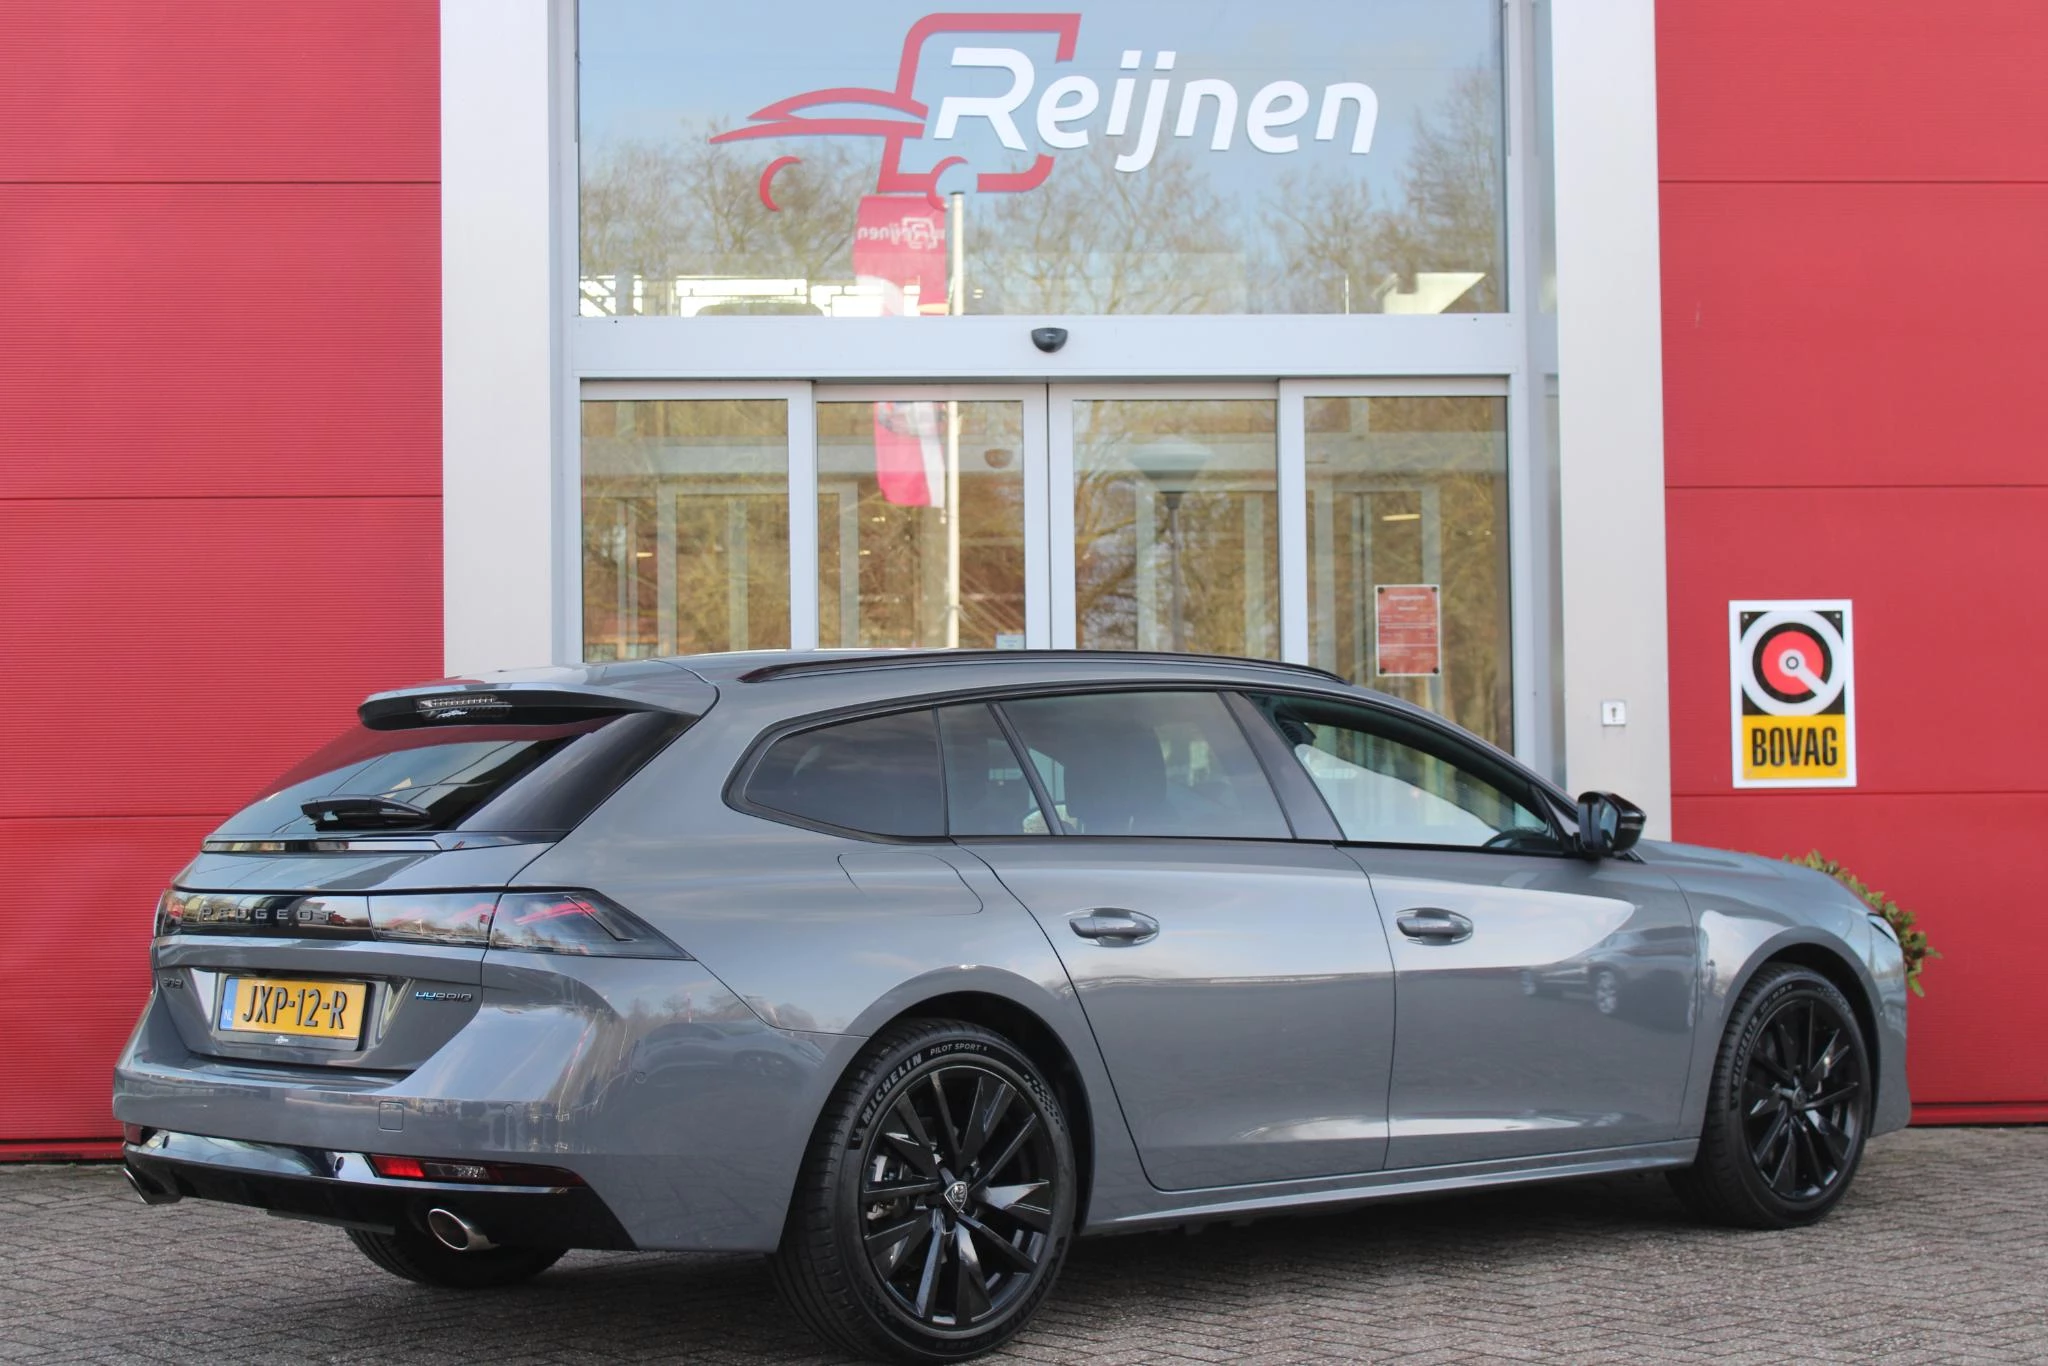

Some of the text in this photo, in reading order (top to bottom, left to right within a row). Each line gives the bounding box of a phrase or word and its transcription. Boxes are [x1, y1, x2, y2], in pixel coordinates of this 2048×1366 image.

[934, 47, 1379, 173] Reijnen
[1752, 727, 1838, 767] BOVAG
[200, 905, 331, 921] PEUGEOT
[223, 1009, 233, 1021] NL
[242, 985, 348, 1030] JXP-12-R
[930, 1043, 953, 1056] PILOT
[954, 1042, 981, 1052] SPORT
[861, 1052, 922, 1125] MICHELIN
